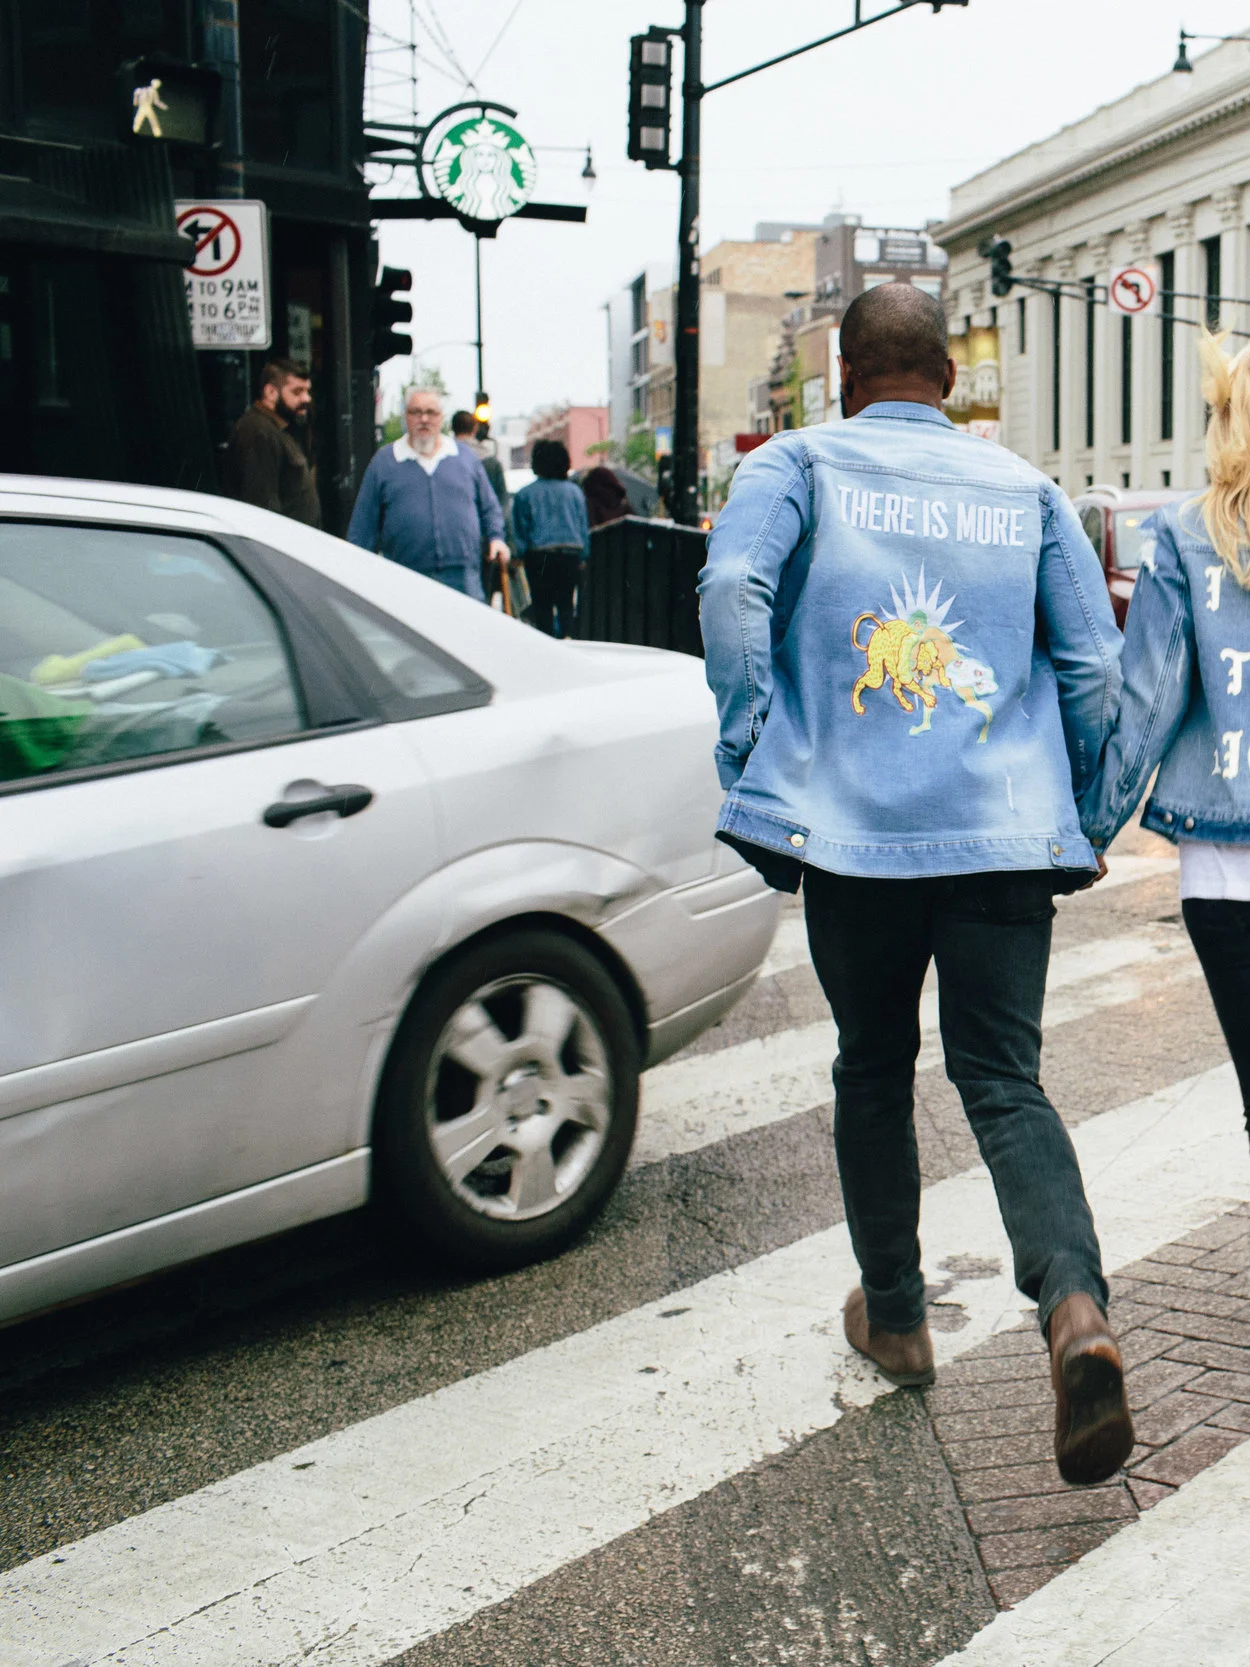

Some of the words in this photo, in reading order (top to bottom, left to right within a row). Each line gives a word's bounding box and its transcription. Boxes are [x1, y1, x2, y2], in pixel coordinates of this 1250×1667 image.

[199, 281, 217, 296] TO
[200, 302, 218, 318] TO
[838, 485, 915, 536] THERE
[922, 499, 949, 540] IS
[956, 502, 1025, 547] MORE
[1204, 565, 1223, 612] I
